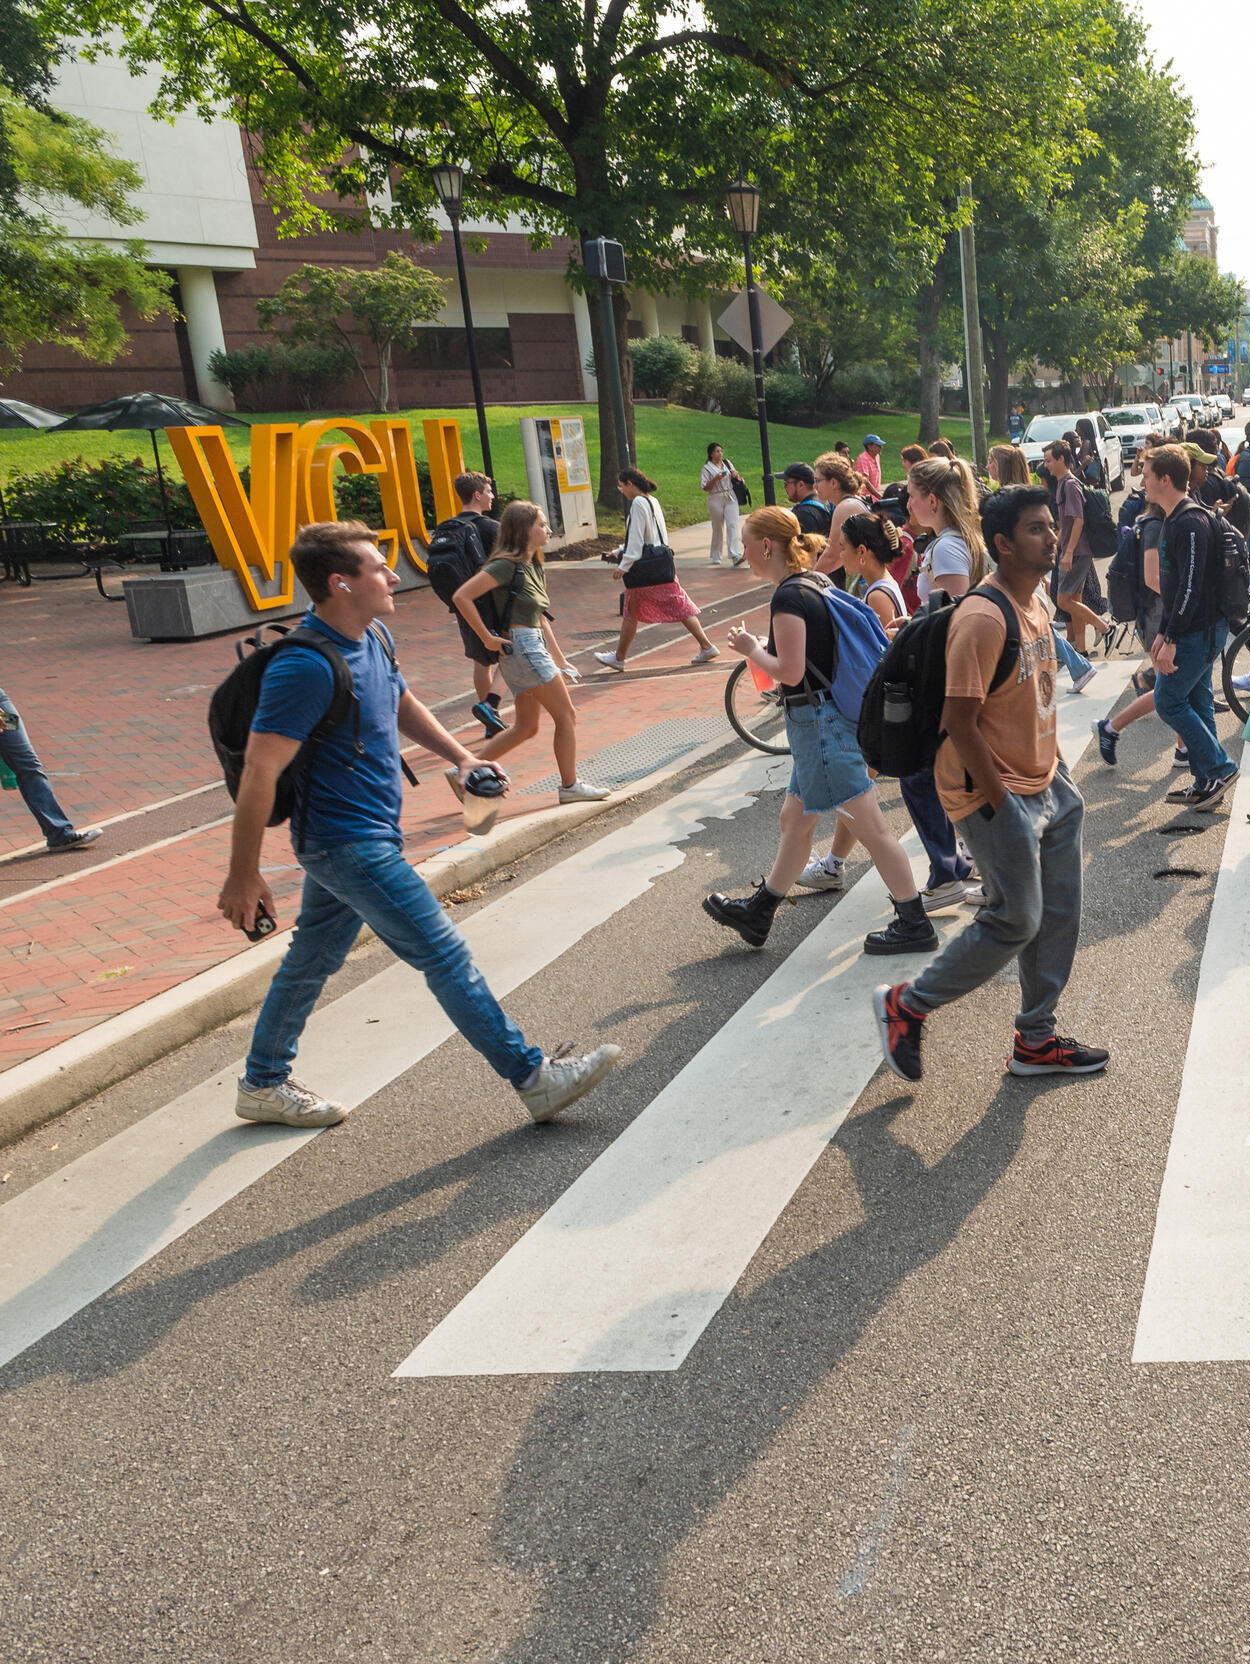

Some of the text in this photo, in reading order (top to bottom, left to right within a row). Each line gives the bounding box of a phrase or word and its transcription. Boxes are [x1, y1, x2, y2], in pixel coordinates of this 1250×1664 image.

[165, 418, 466, 611] VCU
[1187, 564, 1195, 588] Computer
[1178, 588, 1192, 616] Engineering
